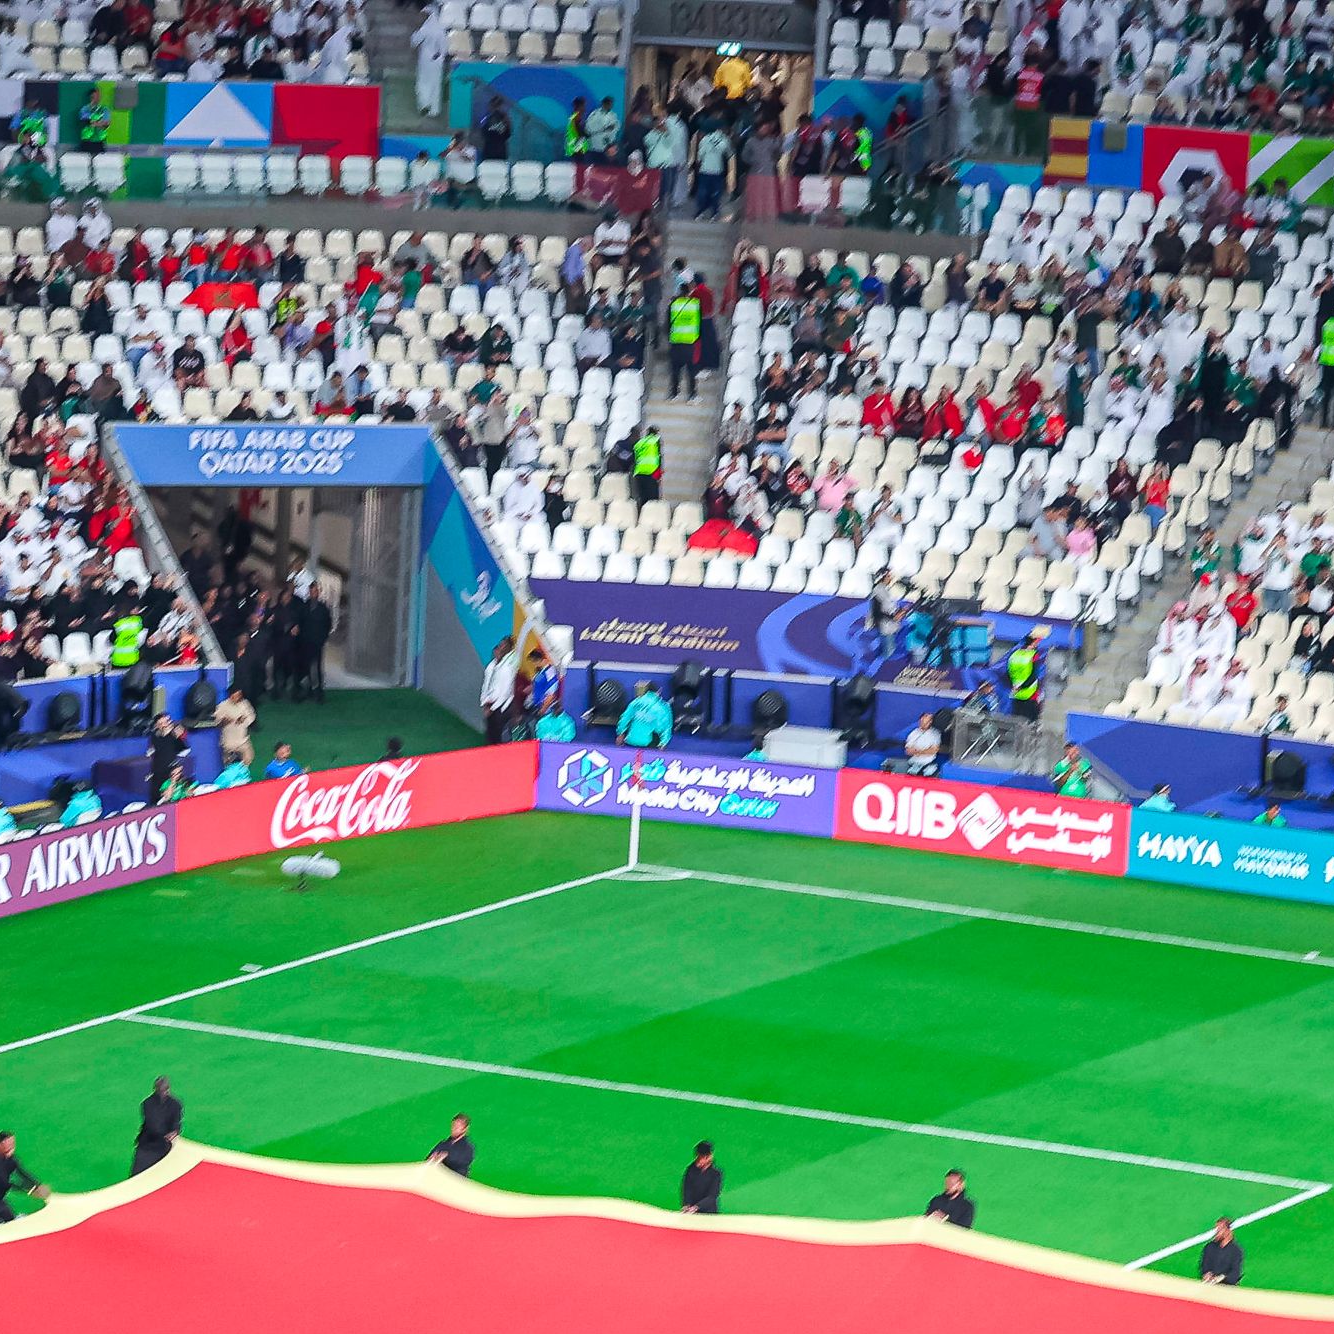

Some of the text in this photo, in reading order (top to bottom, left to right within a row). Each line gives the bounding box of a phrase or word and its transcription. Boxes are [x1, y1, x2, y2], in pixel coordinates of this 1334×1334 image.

[188, 428, 356, 450] FIFA ARAB CUP
[198, 450, 344, 478] QATAR 2025
[270, 757, 423, 849] Coca-Cola
[852, 781, 958, 840] QIIB
[20, 812, 167, 898] AIRWAYS
[1136, 830, 1223, 868] HAYYA
